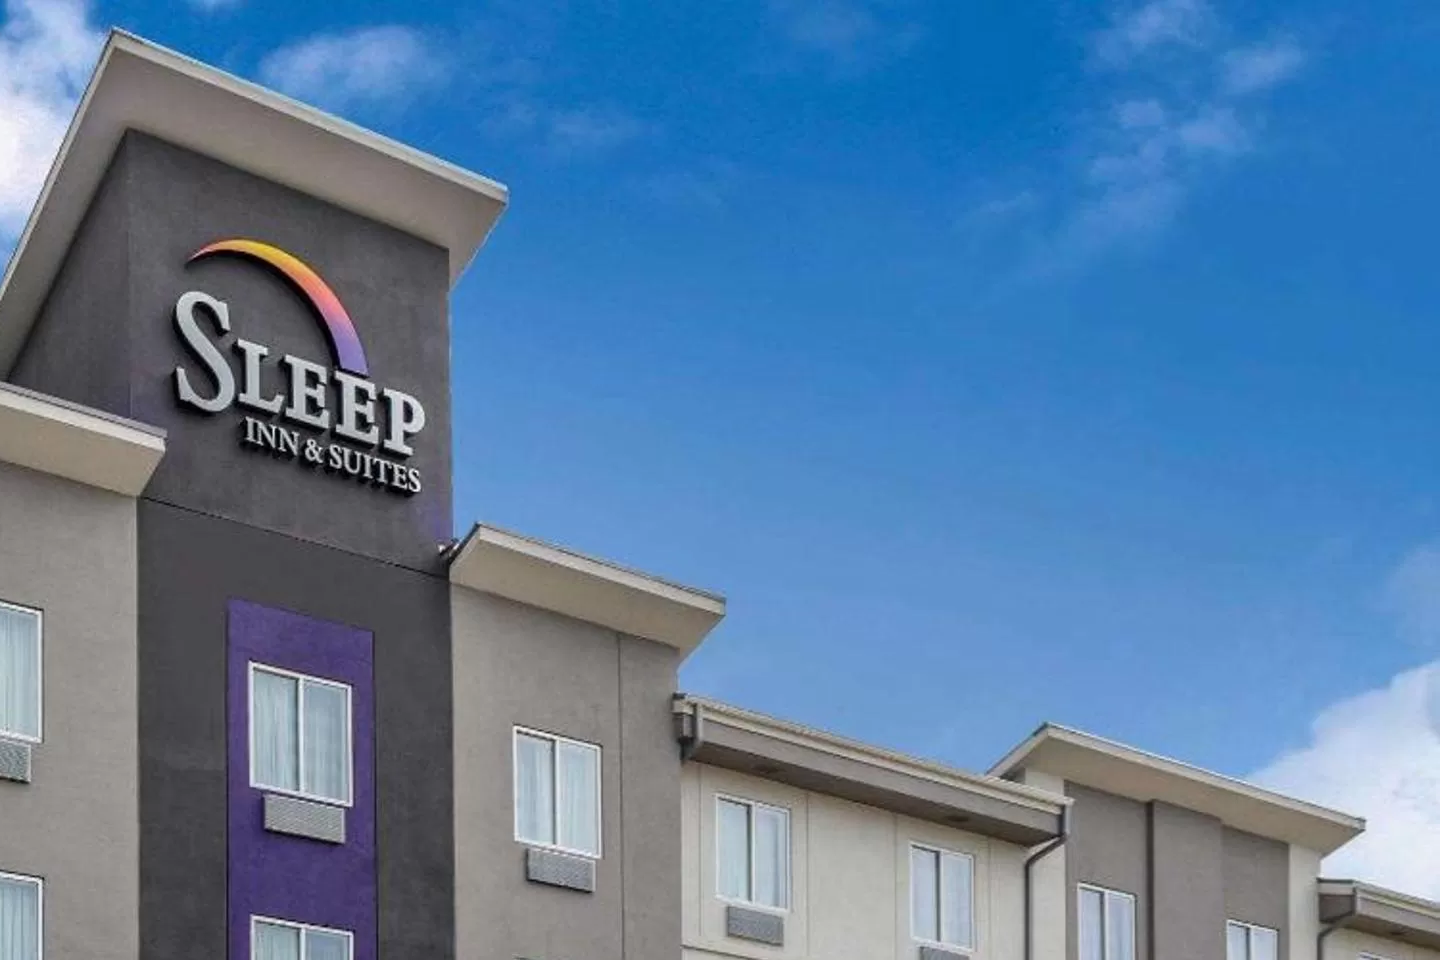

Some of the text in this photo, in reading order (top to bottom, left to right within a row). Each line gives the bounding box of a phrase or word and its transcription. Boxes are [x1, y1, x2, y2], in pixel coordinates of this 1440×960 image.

[175, 291, 425, 456] SLEEP
[245, 416, 422, 493] INN & SUITES
